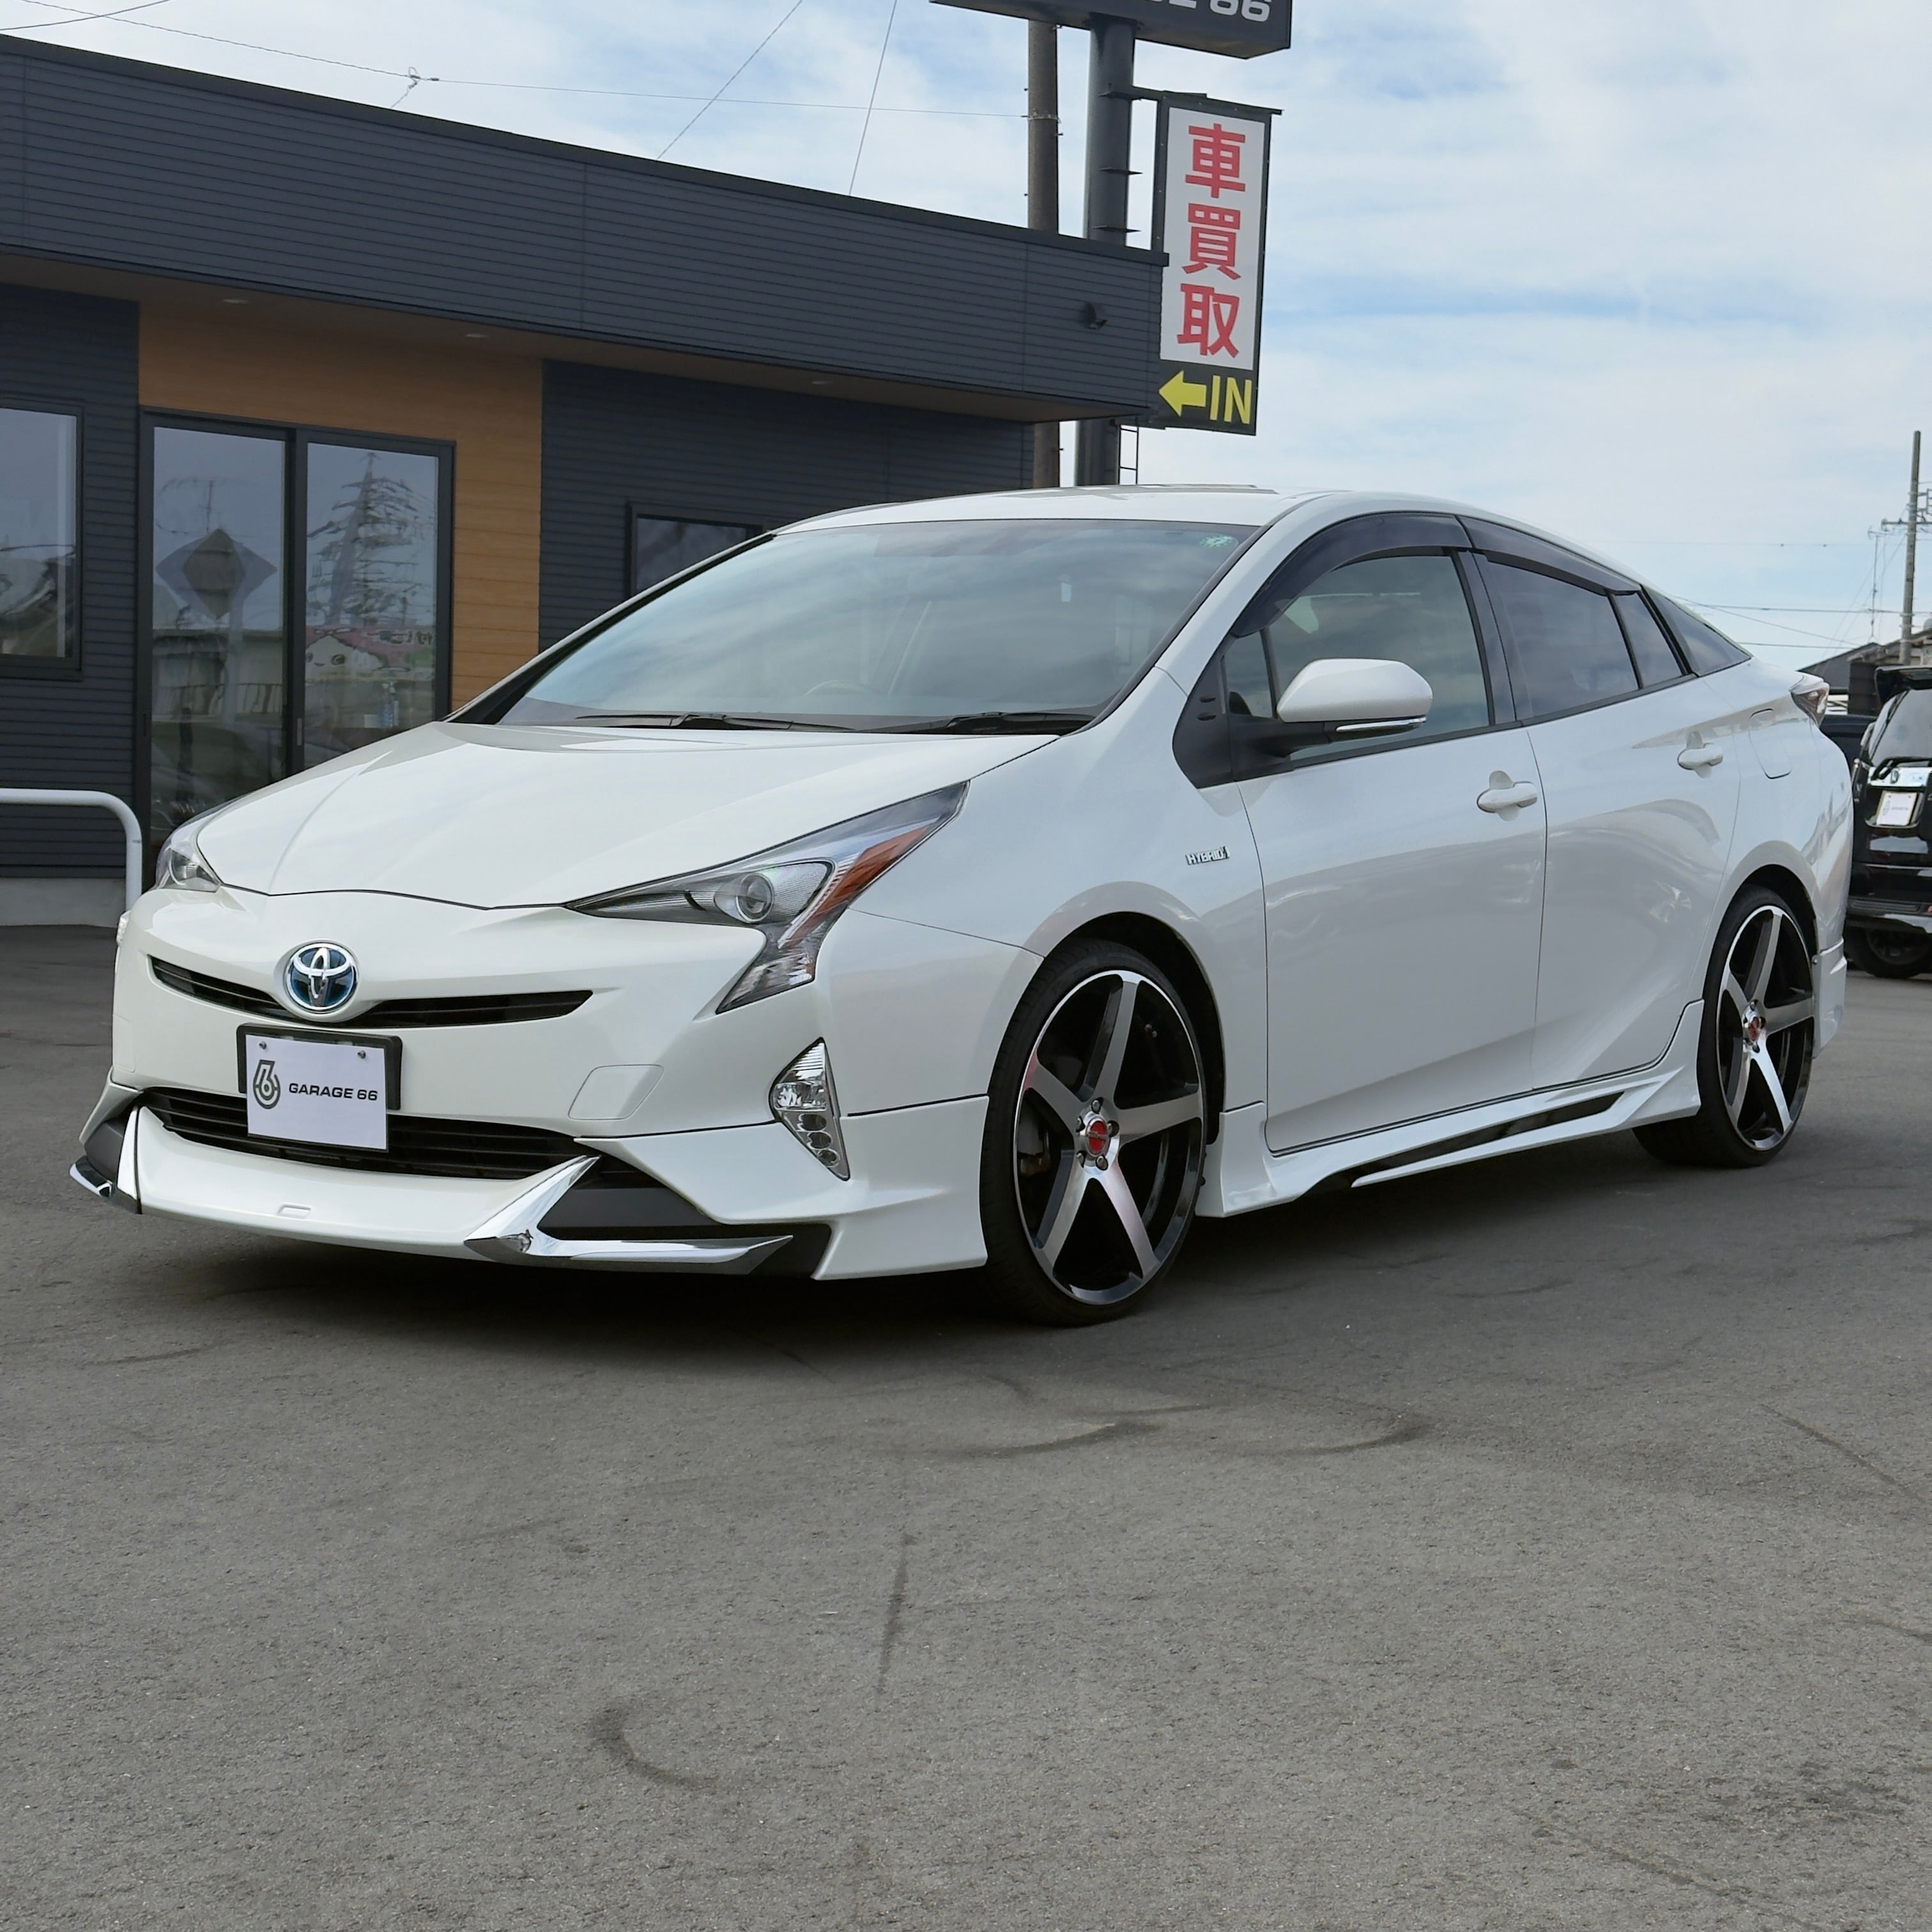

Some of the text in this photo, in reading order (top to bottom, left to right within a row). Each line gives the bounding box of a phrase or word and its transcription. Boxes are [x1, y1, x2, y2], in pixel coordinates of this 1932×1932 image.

[1177, 123, 1245, 358] 車買取
[1209, 375, 1252, 424] IN
[1185, 847, 1229, 865] HYBRID
[289, 1083, 378, 1101] GARAGE 66
